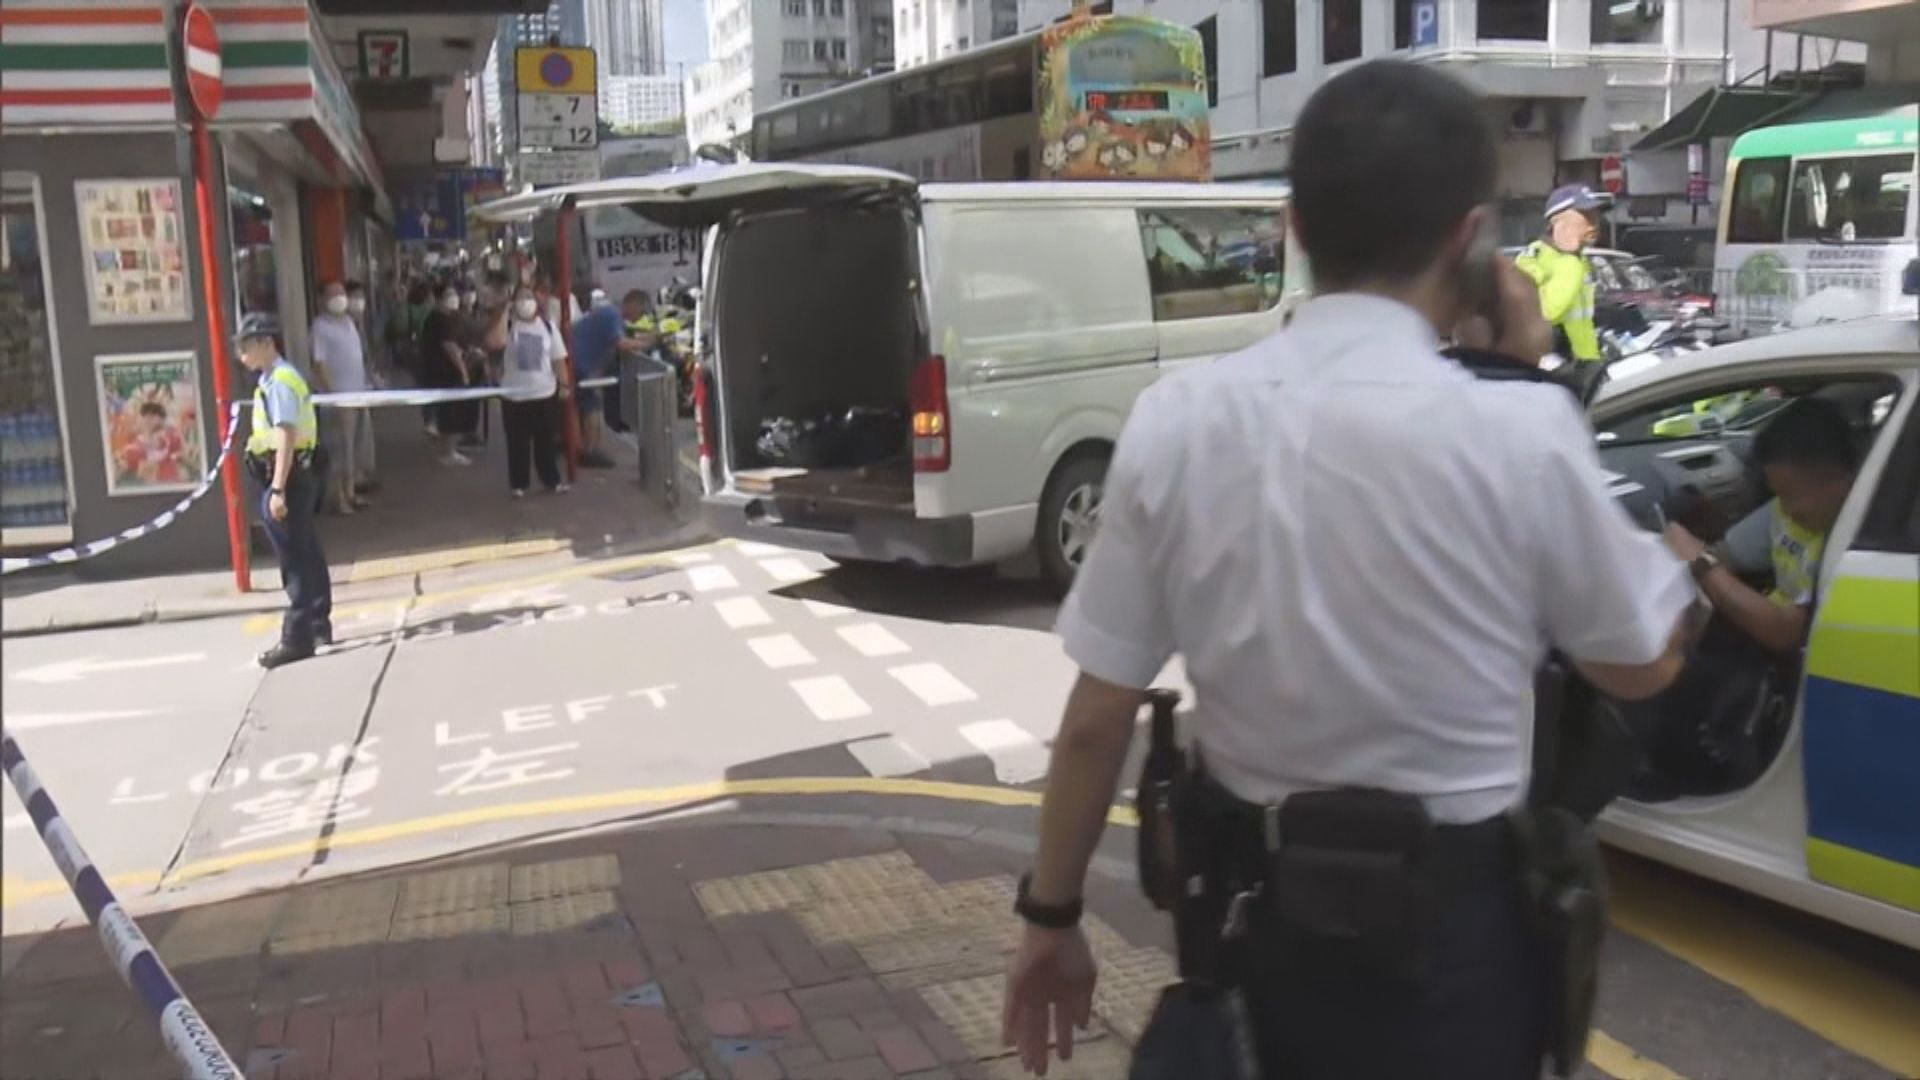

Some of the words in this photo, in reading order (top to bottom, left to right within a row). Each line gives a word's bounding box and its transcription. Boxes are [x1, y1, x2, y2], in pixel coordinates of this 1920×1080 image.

[1416, 4, 1435, 42] P
[567, 95, 580, 114] 7
[568, 126, 593, 144] 12
[109, 736, 381, 804] LOOK
[434, 682, 678, 746] LEFT
